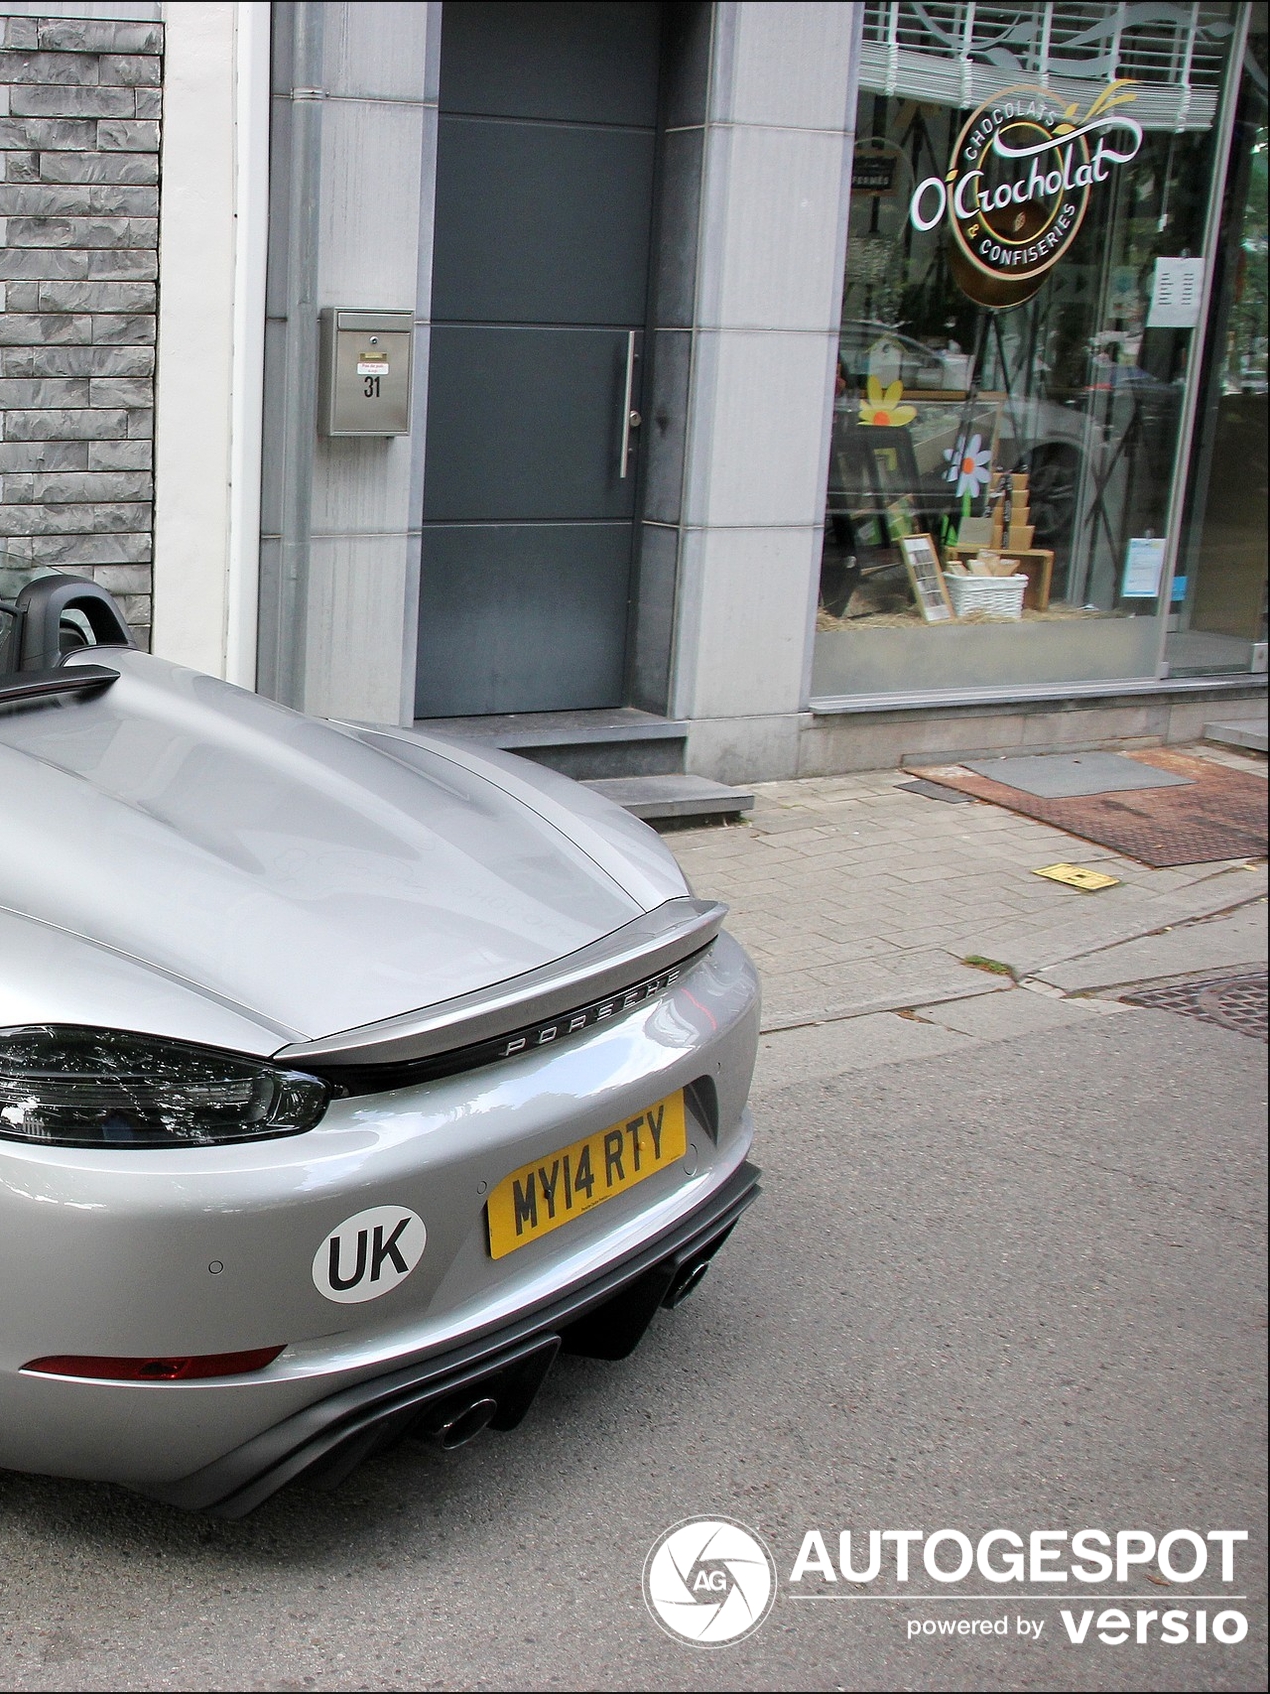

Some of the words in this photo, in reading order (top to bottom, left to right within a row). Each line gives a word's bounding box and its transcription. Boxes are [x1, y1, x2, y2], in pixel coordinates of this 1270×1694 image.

[964, 101, 1056, 161] CHOCOLATS
[980, 203, 1075, 266] CONFISERIES
[364, 376, 380, 397] 31
[503, 970, 681, 1057] PORSCHE
[512, 1143, 595, 1237] MY14
[603, 1104, 665, 1188] RTY
[329, 1216, 413, 1291] UK
